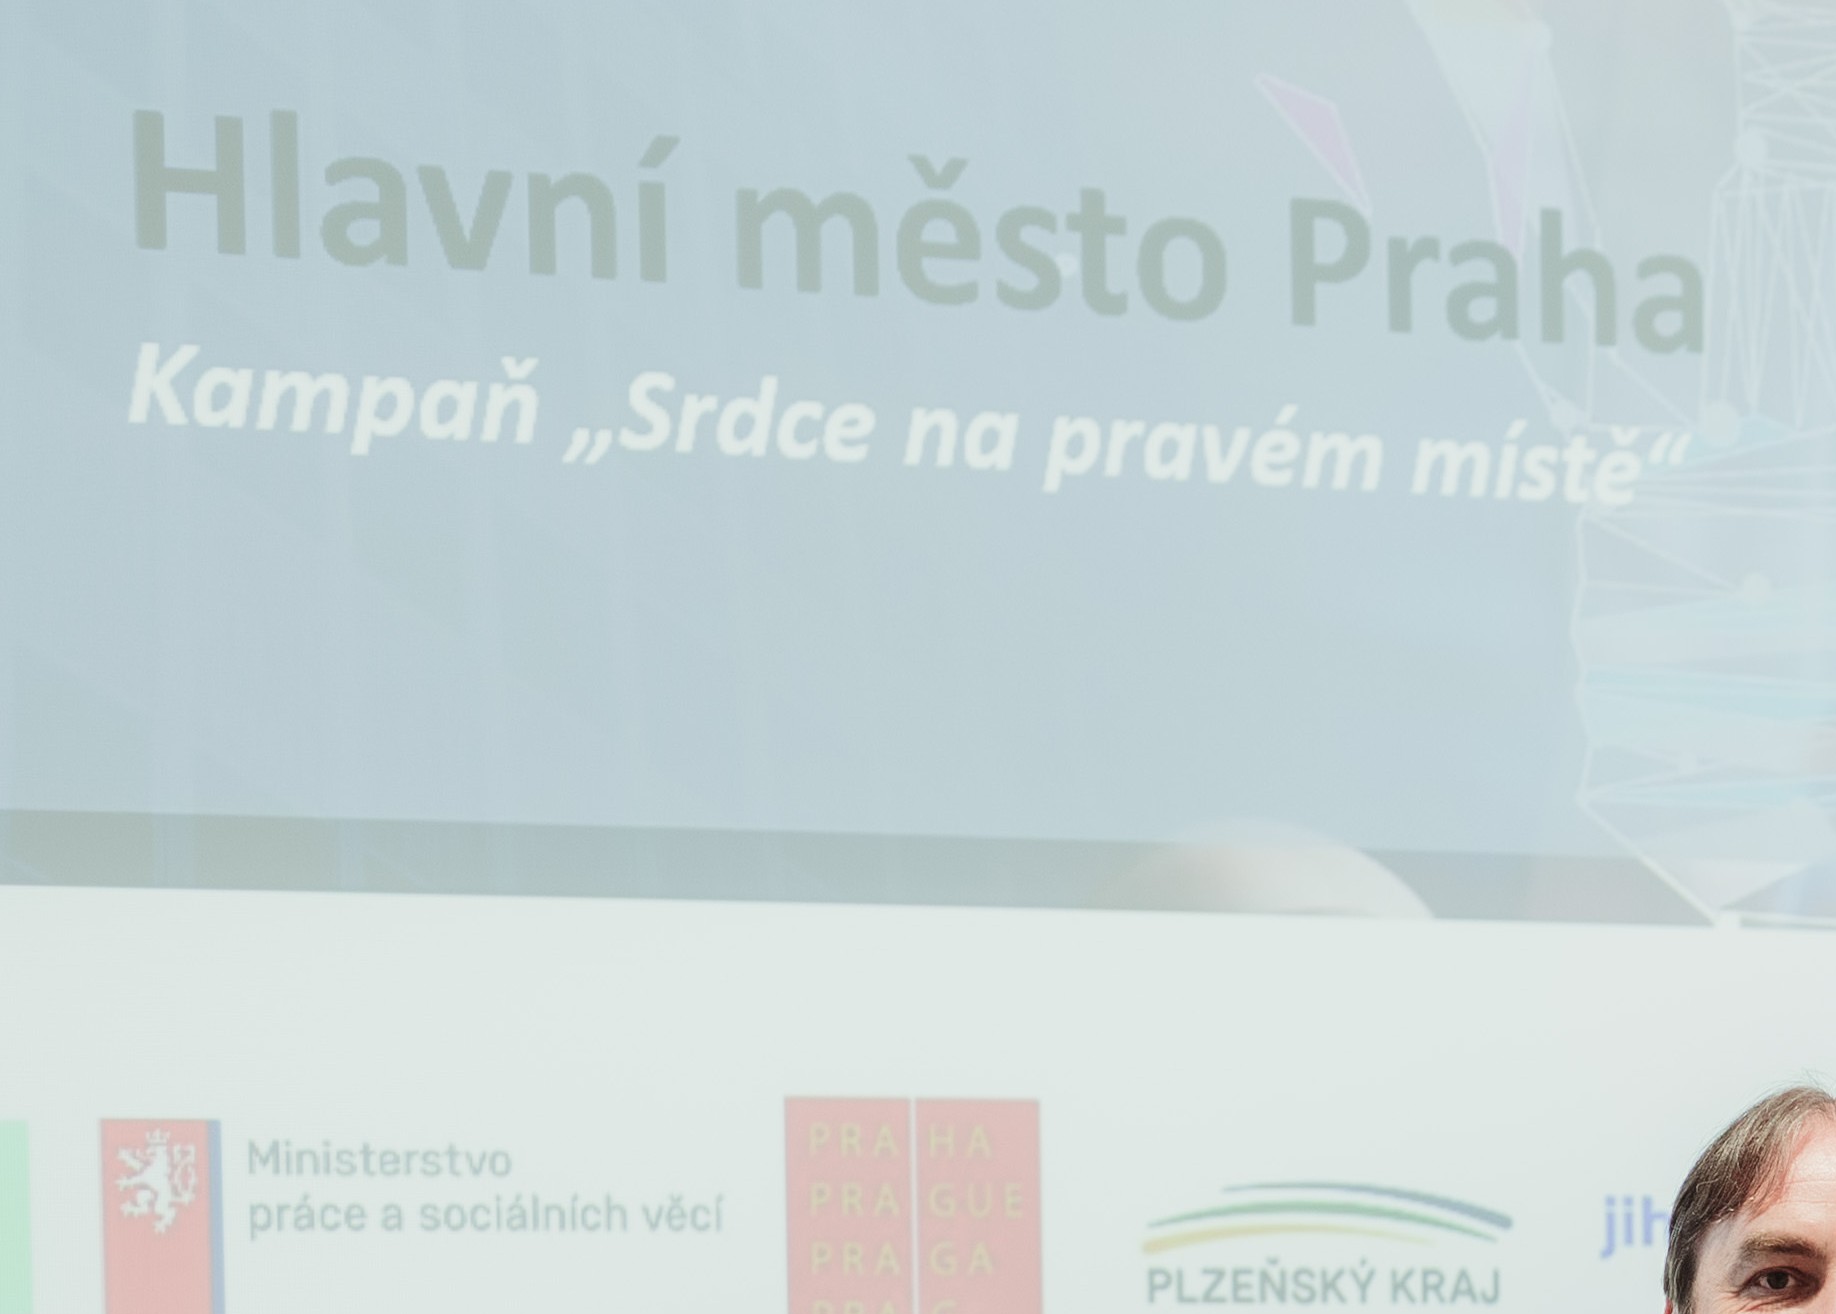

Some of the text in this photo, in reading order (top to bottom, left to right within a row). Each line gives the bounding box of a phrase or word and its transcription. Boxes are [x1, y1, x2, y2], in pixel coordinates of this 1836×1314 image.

[132, 109, 1704, 354] Hlavní město Praha
[128, 342, 539, 455] Kampaň
[903, 406, 1018, 470] na
[1043, 404, 1383, 493] pravém
[246, 1139, 513, 1178] Ministerstvo
[249, 1193, 724, 1241] práce a sociálních věcí
[1146, 1258, 1500, 1306] PLZEŇSKÝ KRAJ
